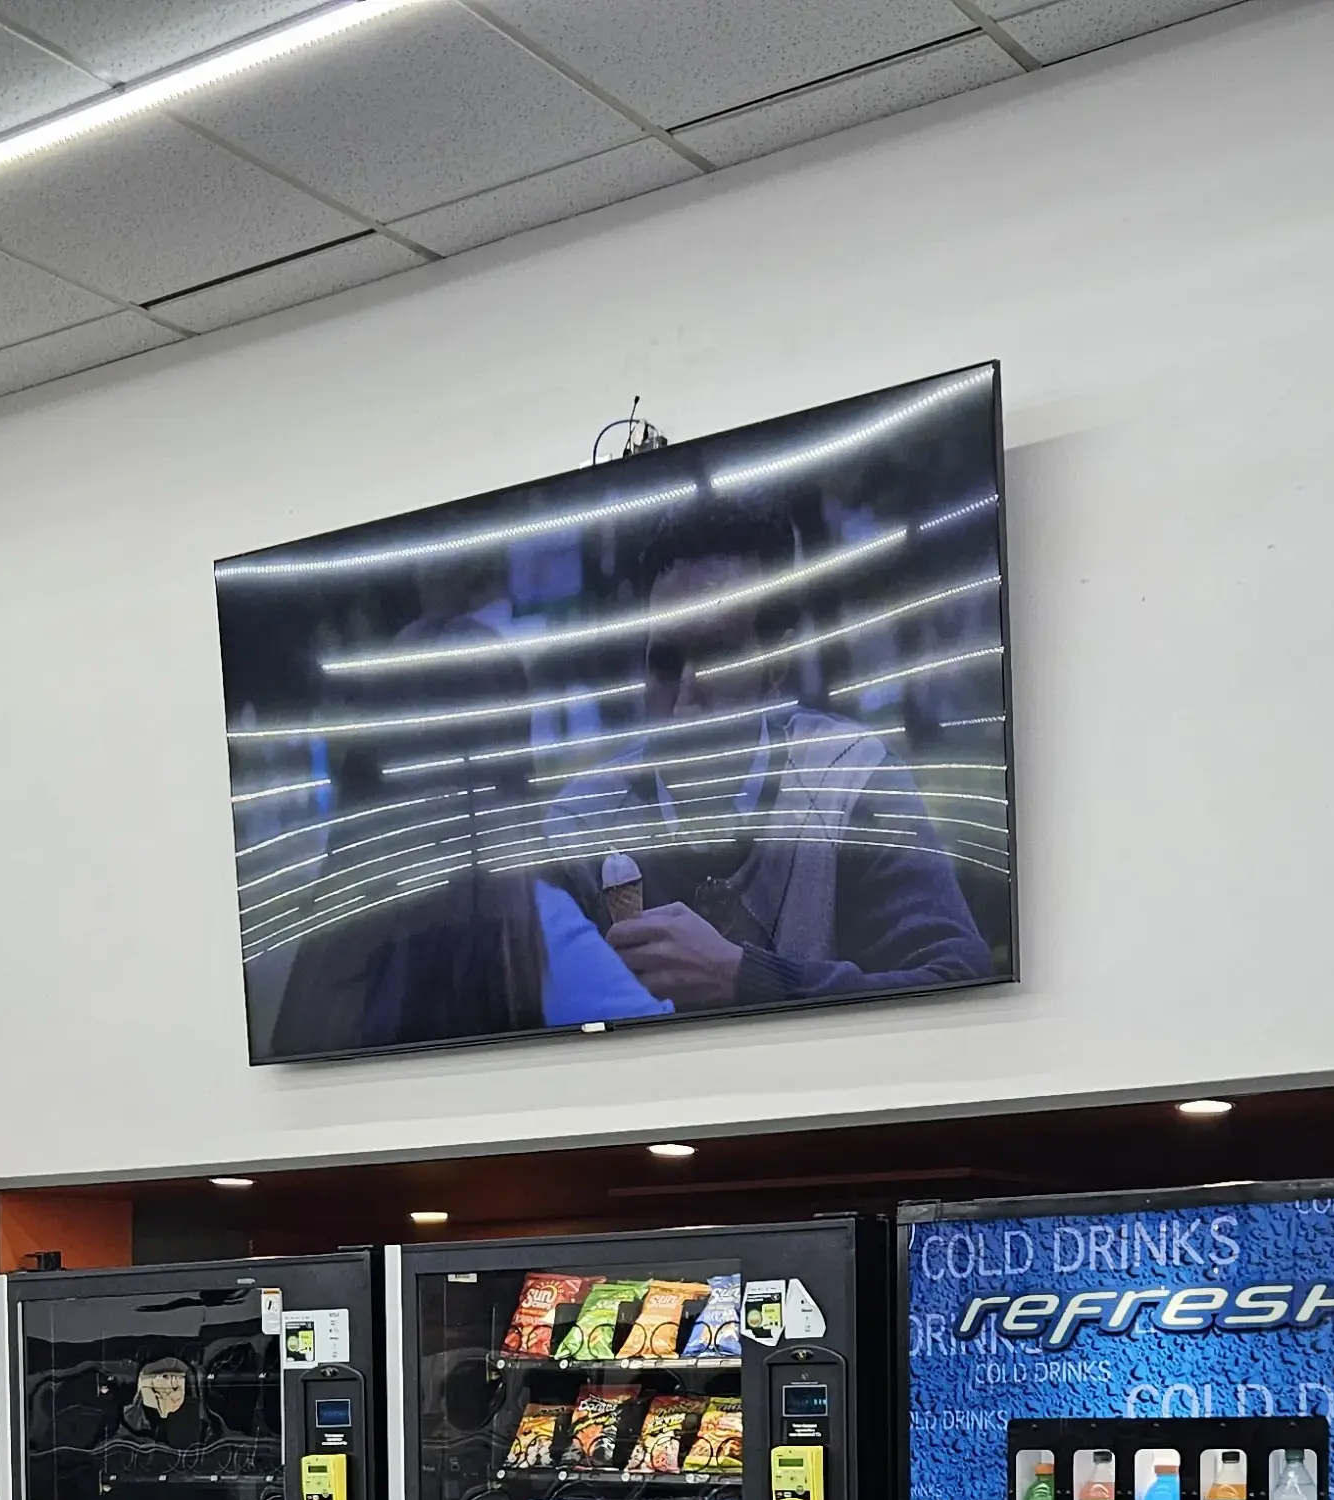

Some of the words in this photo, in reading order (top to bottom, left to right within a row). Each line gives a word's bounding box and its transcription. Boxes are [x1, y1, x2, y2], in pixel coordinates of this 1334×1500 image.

[921, 1230, 1034, 1280] COLD
[1053, 1215, 1240, 1273] DRINKS
[521, 1287, 553, 1307] Sun
[975, 1362, 1027, 1385] COLD
[1034, 1359, 1112, 1383] DRINKS
[909, 1412, 937, 1431] LD
[942, 1410, 1008, 1431] DRINKS
